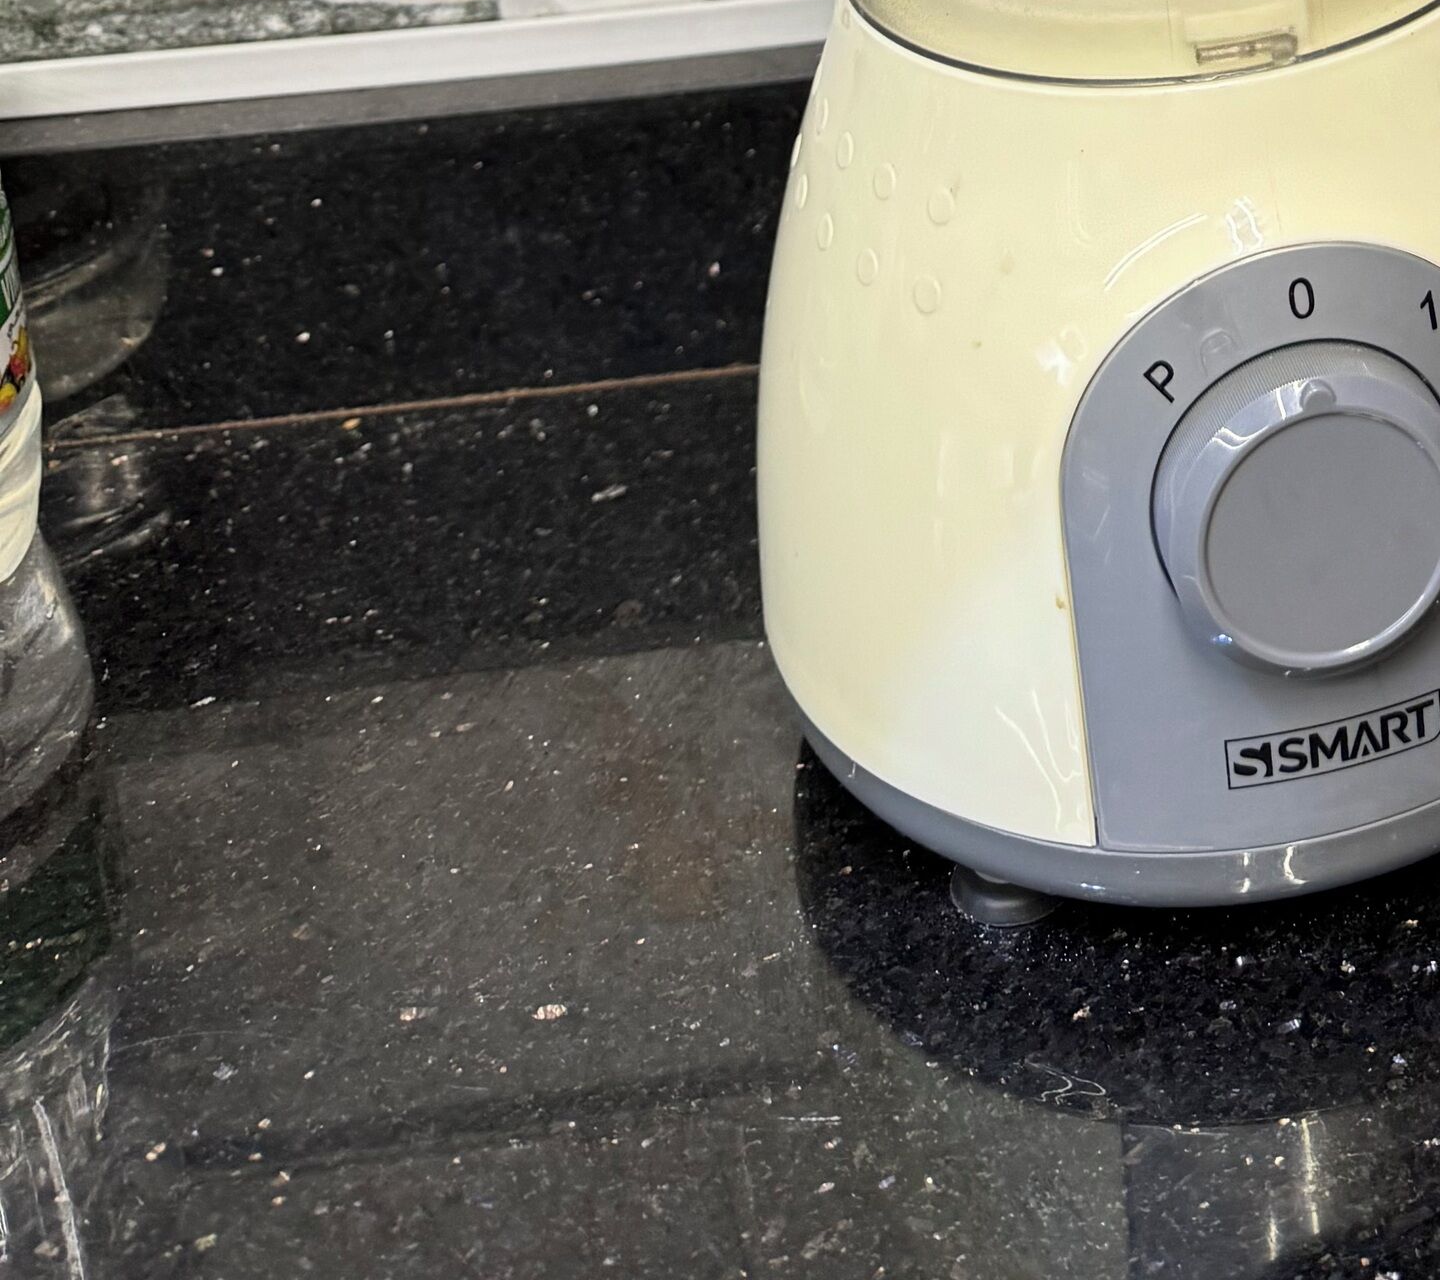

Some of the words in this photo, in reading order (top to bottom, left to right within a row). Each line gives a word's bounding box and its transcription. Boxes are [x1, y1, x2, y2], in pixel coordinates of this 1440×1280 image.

[1288, 278, 1315, 319] 0
[1420, 290, 1438, 330] 1
[1143, 360, 1174, 403] P
[1278, 699, 1434, 773] SMART
